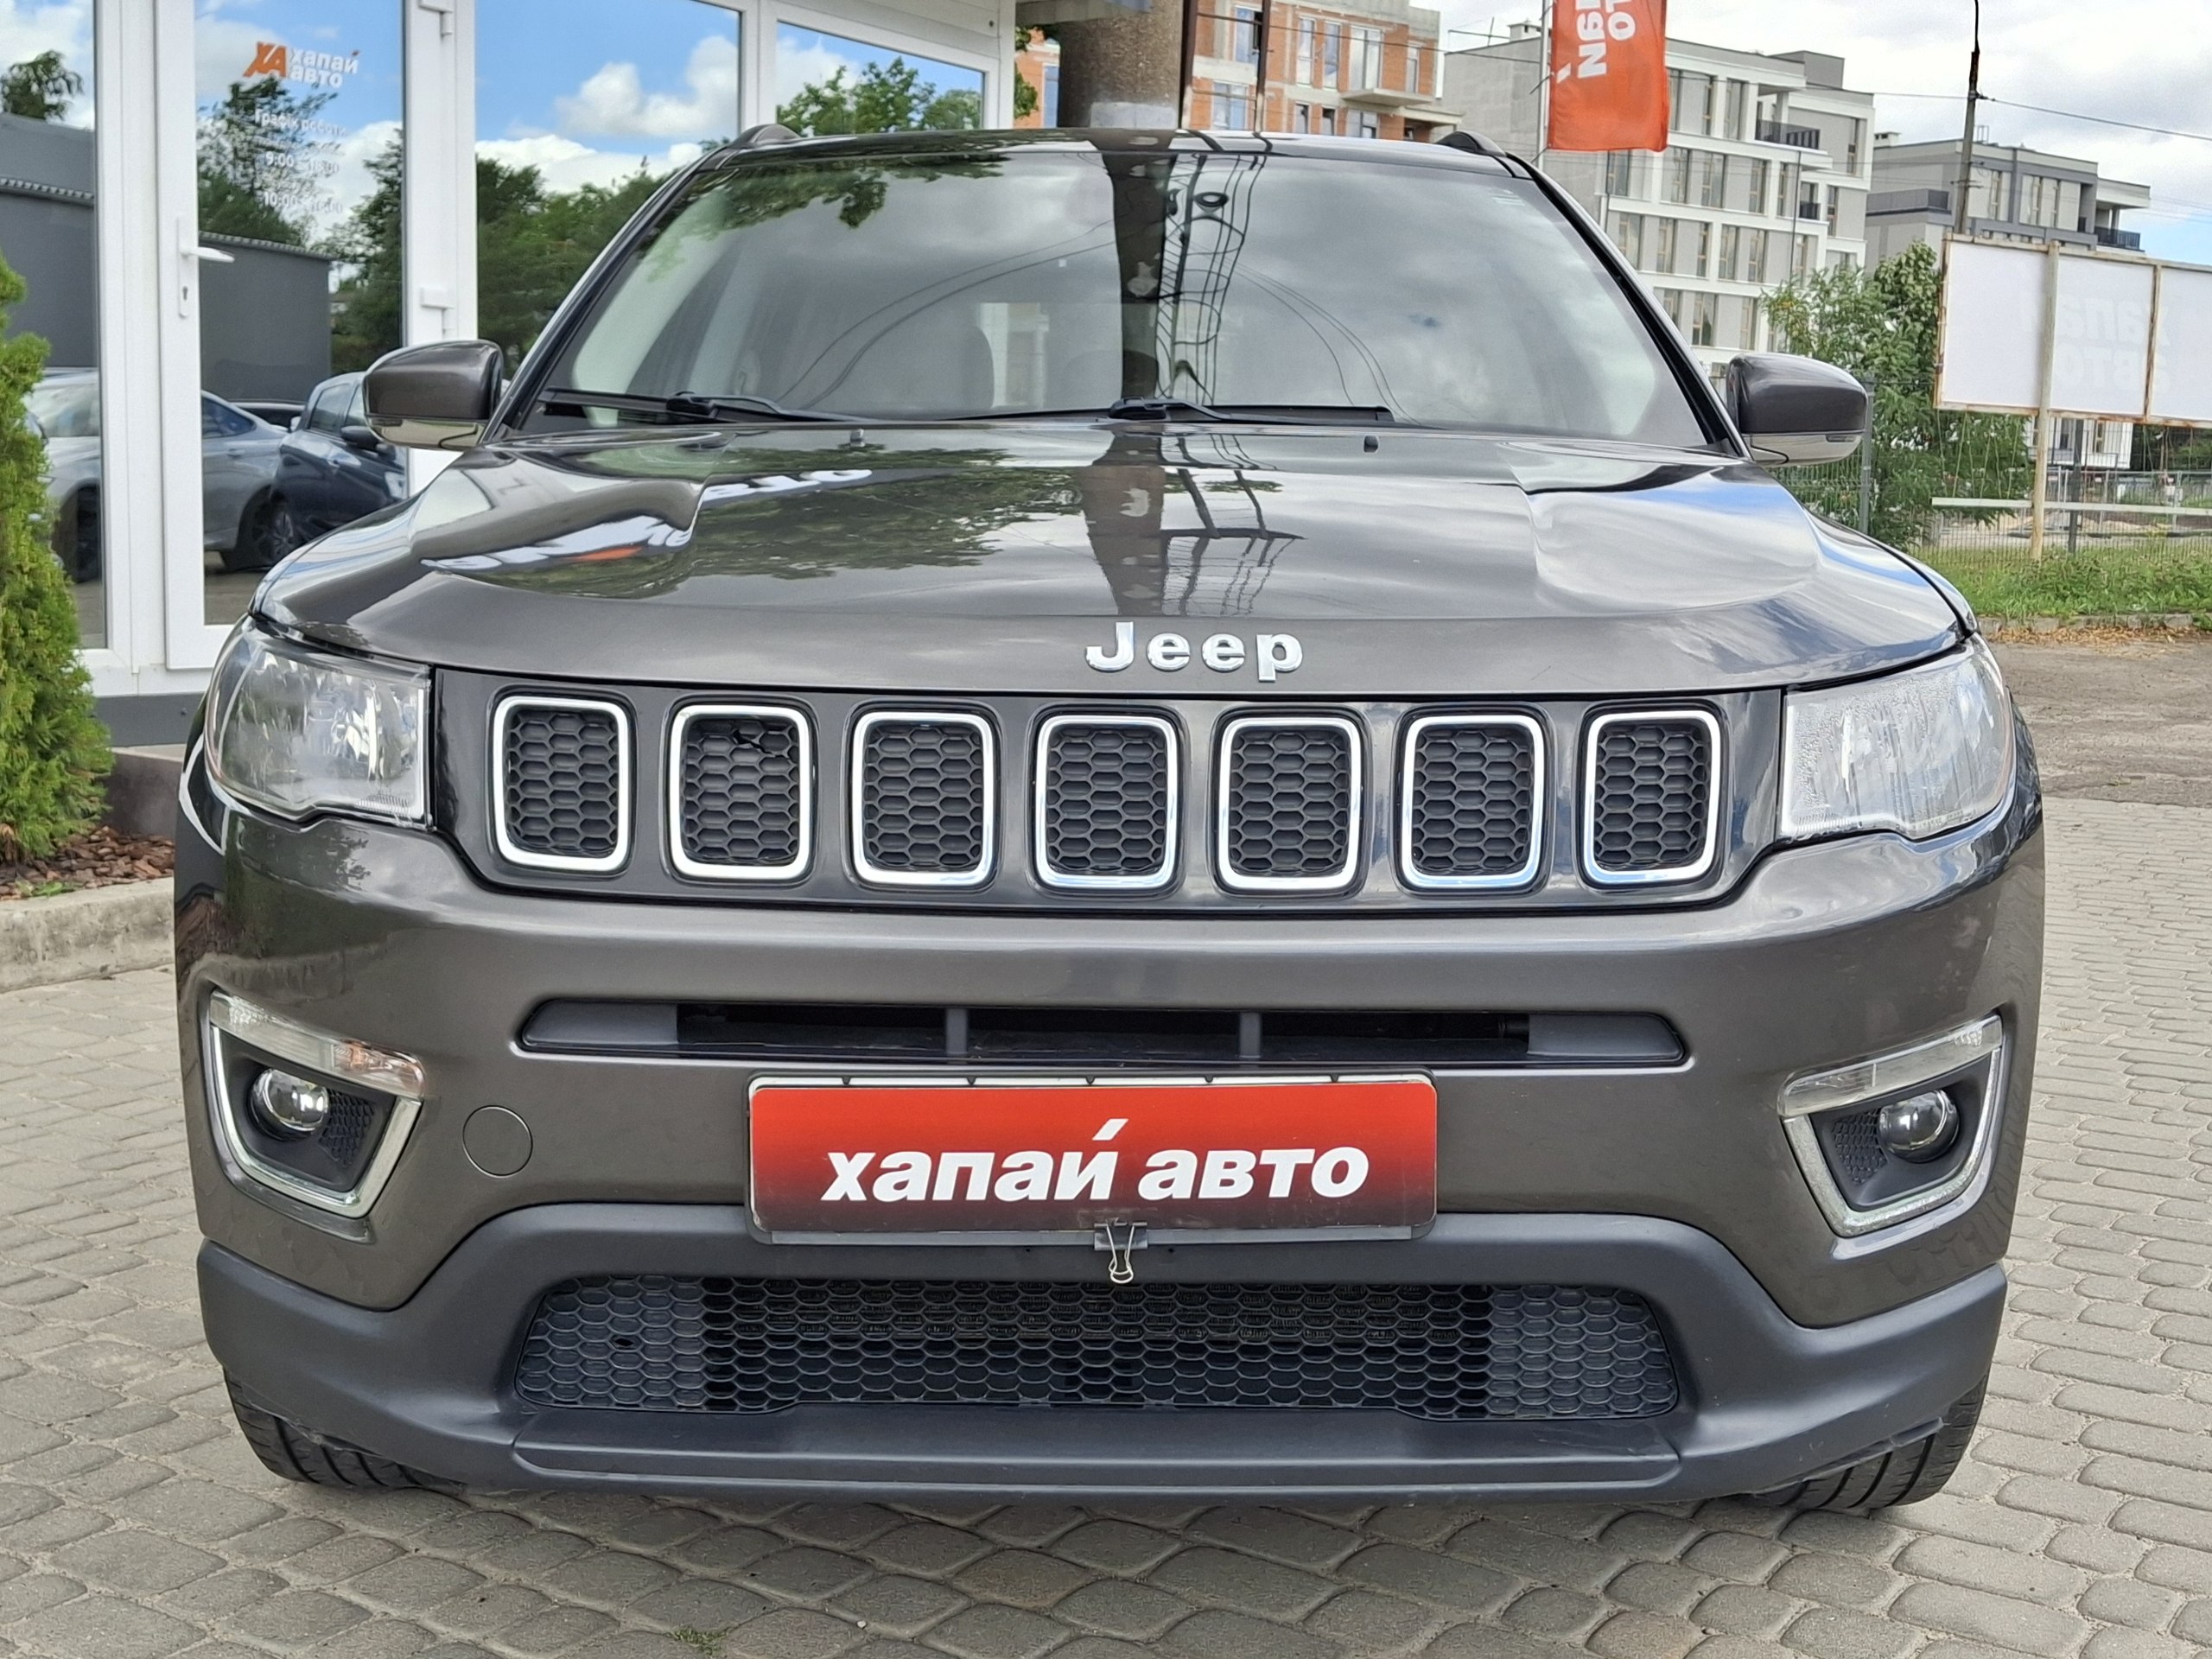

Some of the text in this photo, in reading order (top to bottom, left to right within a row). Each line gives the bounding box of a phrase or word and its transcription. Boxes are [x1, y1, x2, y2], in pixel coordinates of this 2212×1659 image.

[290, 48, 360, 75] хапай
[289, 65, 343, 89] авто
[265, 150, 296, 168] 9:00
[1085, 621, 1304, 682] Jeep
[820, 1118, 1370, 1202] хапай авто
